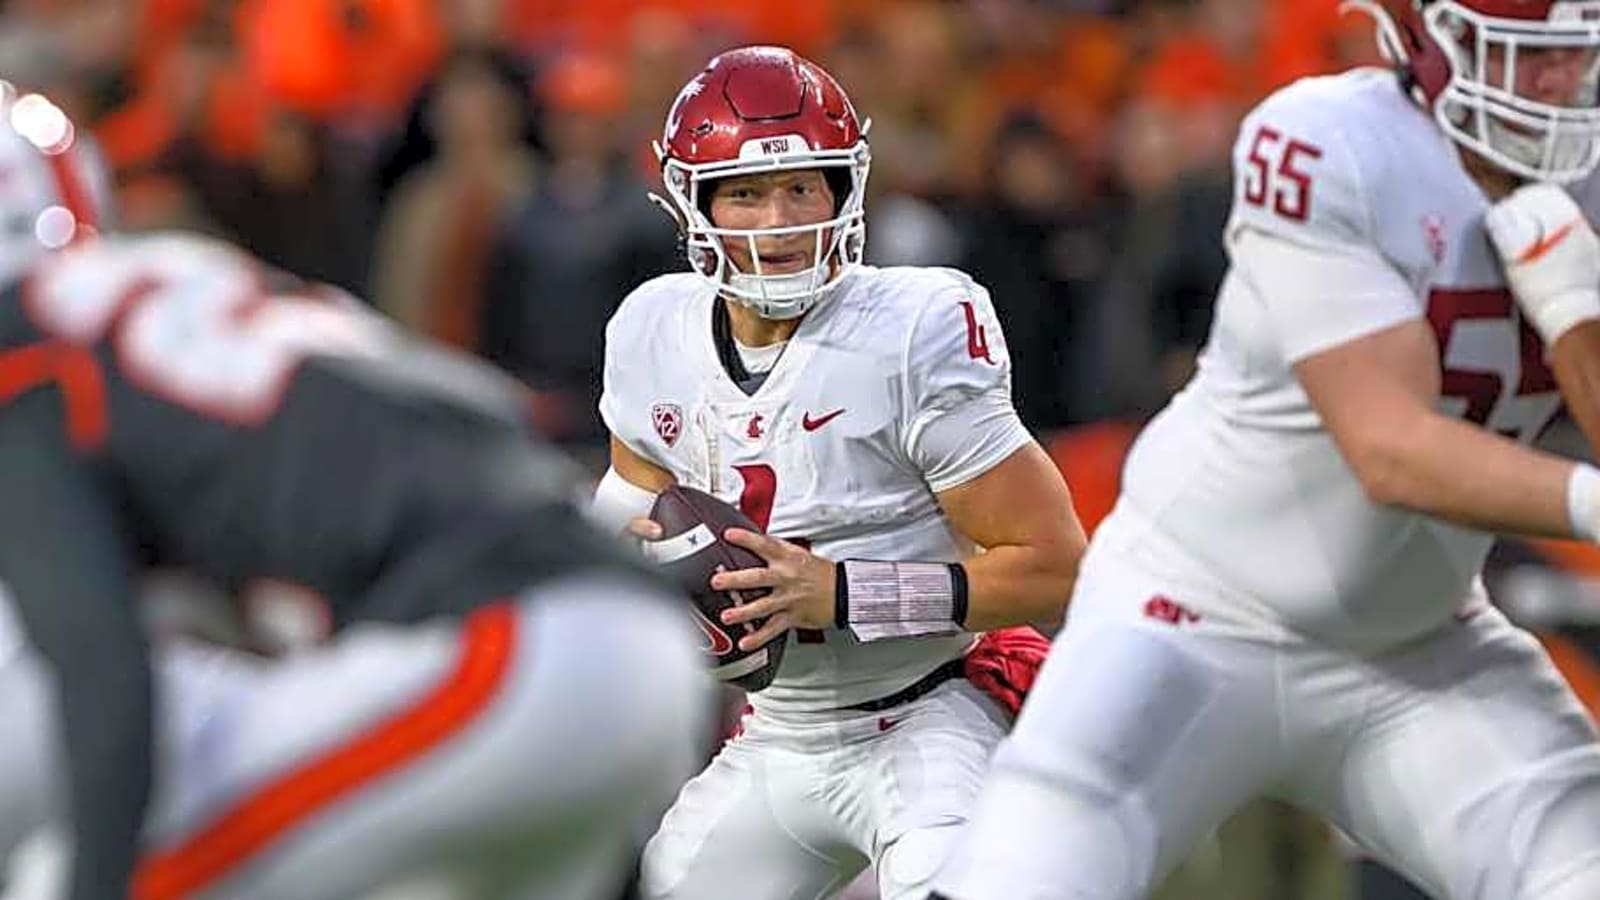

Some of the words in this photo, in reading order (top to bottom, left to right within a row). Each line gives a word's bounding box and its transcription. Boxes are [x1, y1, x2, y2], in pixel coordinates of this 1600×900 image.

[760, 138, 789, 155] WSU
[1244, 126, 1324, 222] 55
[957, 301, 997, 366] 4
[660, 421, 677, 437] 12
